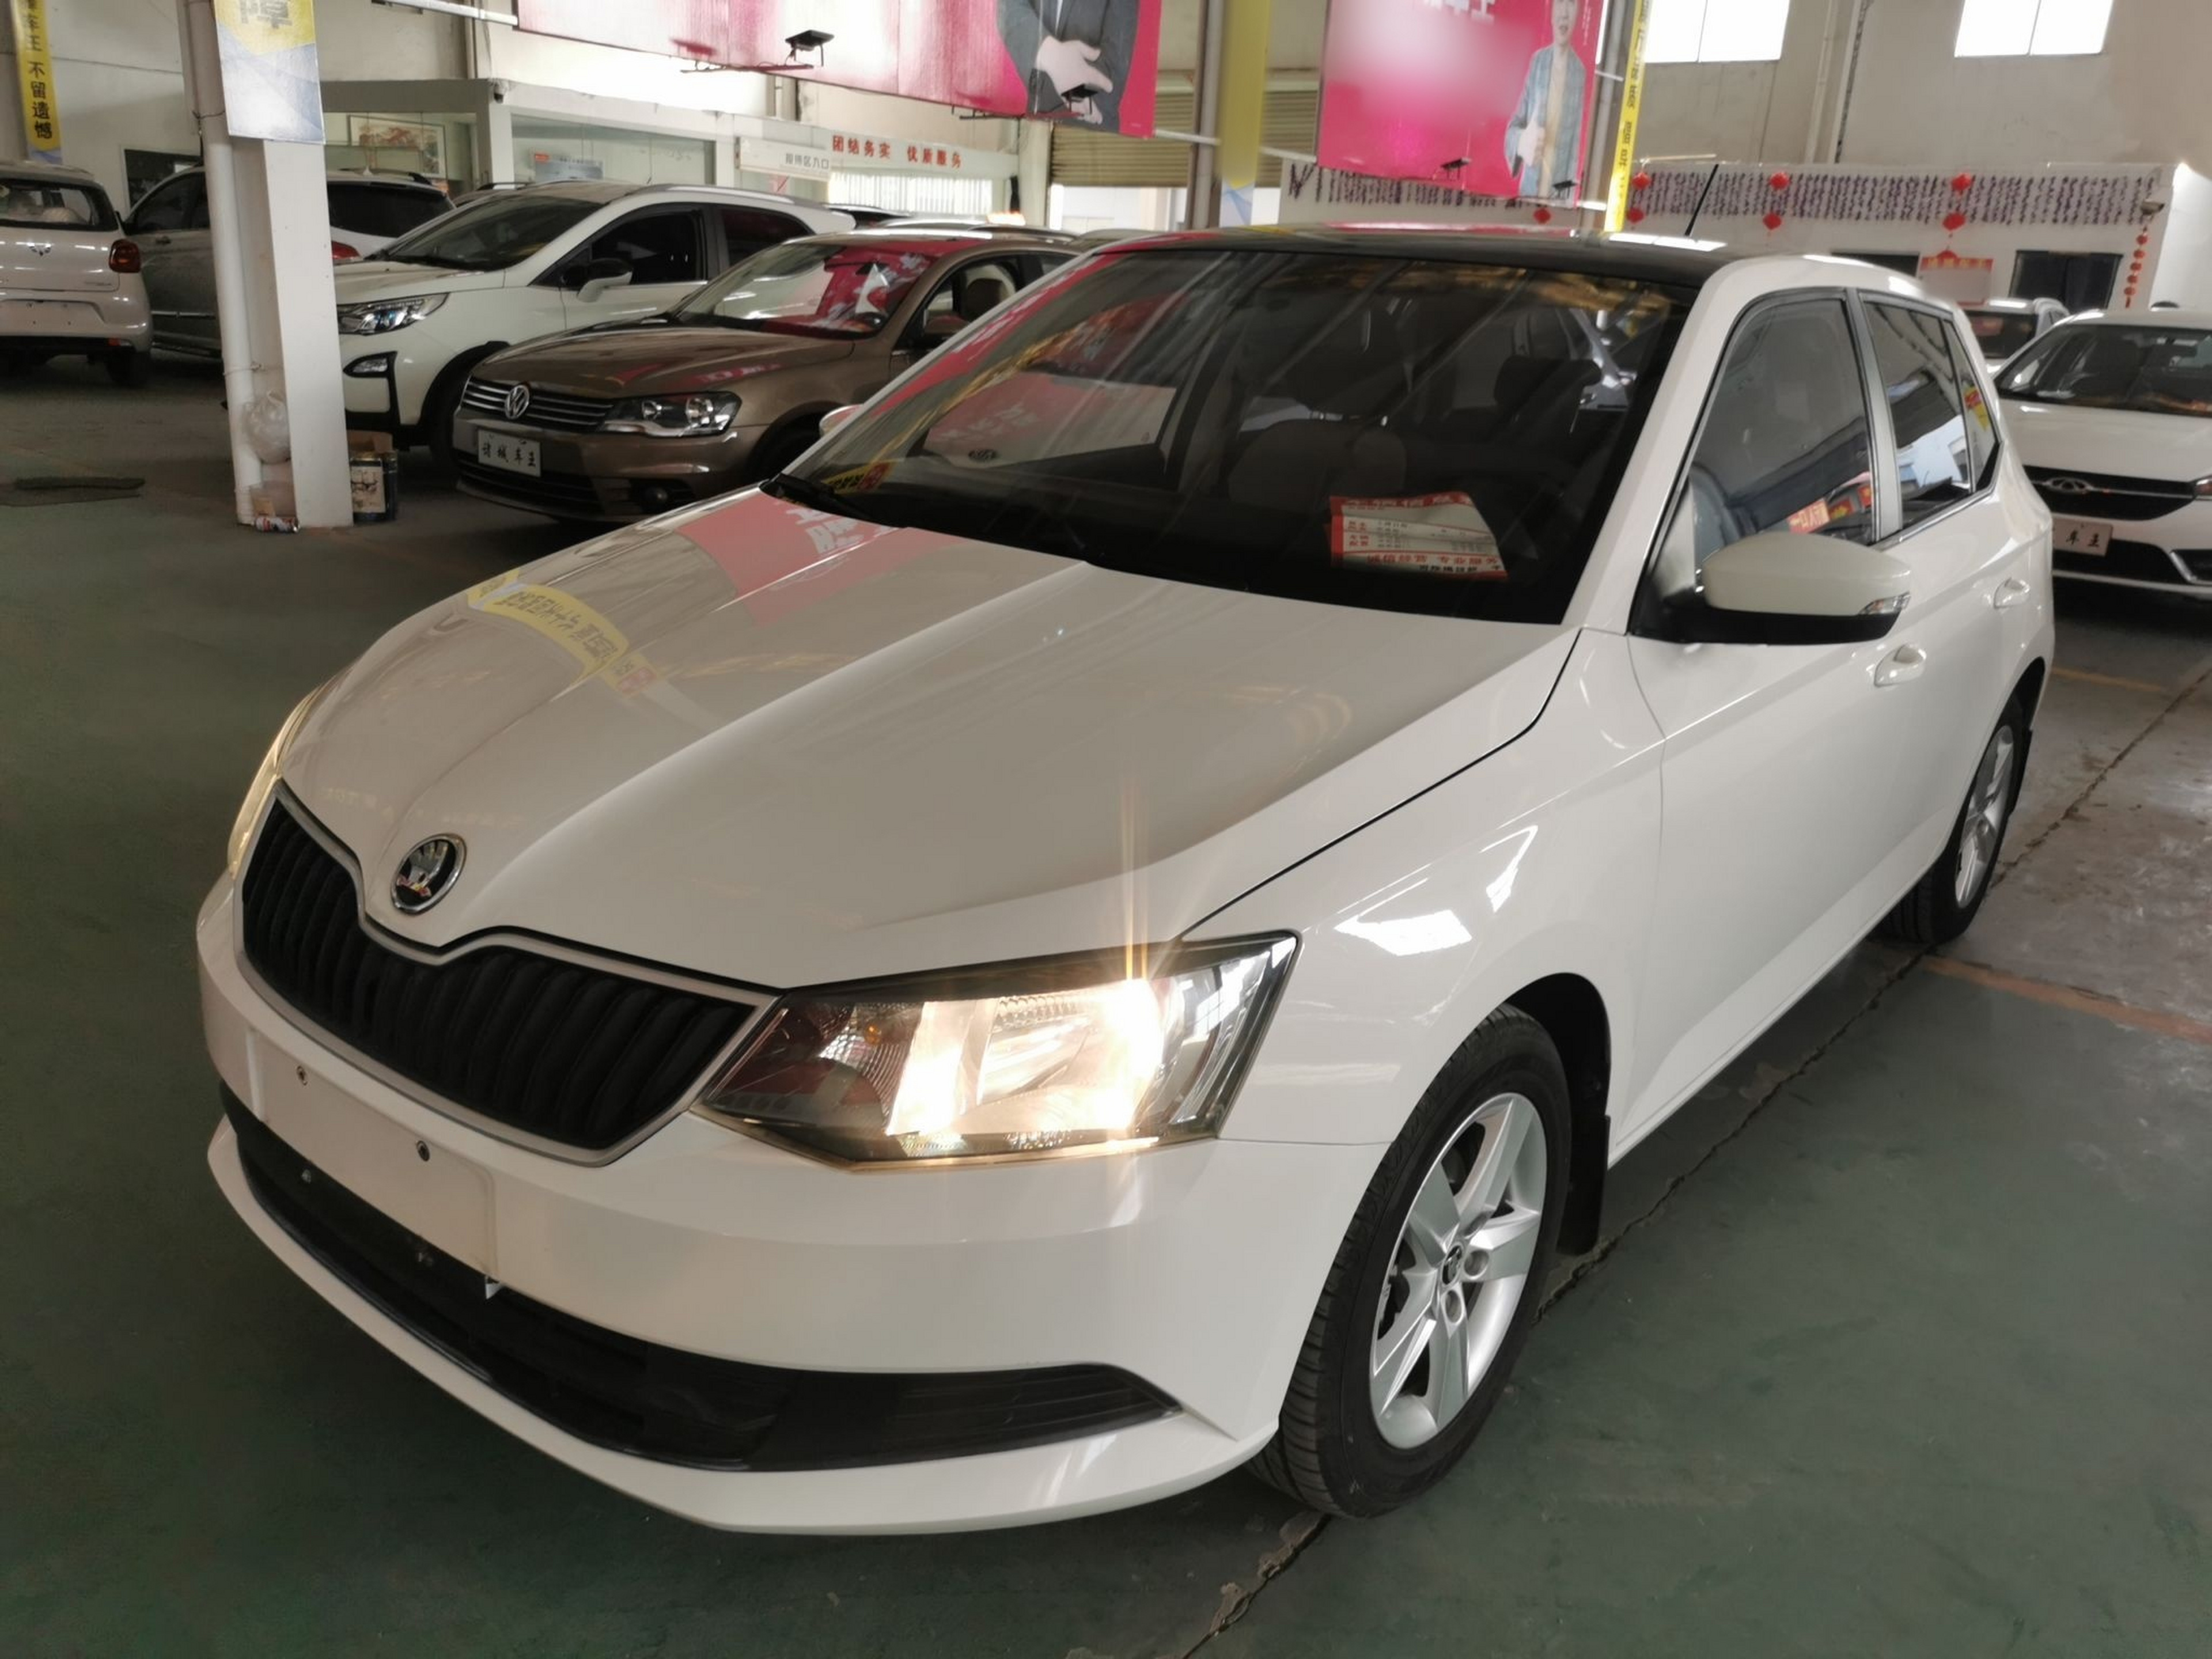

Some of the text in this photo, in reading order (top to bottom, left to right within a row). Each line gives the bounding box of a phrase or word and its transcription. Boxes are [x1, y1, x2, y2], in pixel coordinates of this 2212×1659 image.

[28, 61, 52, 140] 不留遗憾
[832, 134, 963, 169] 团结务实 优质服务
